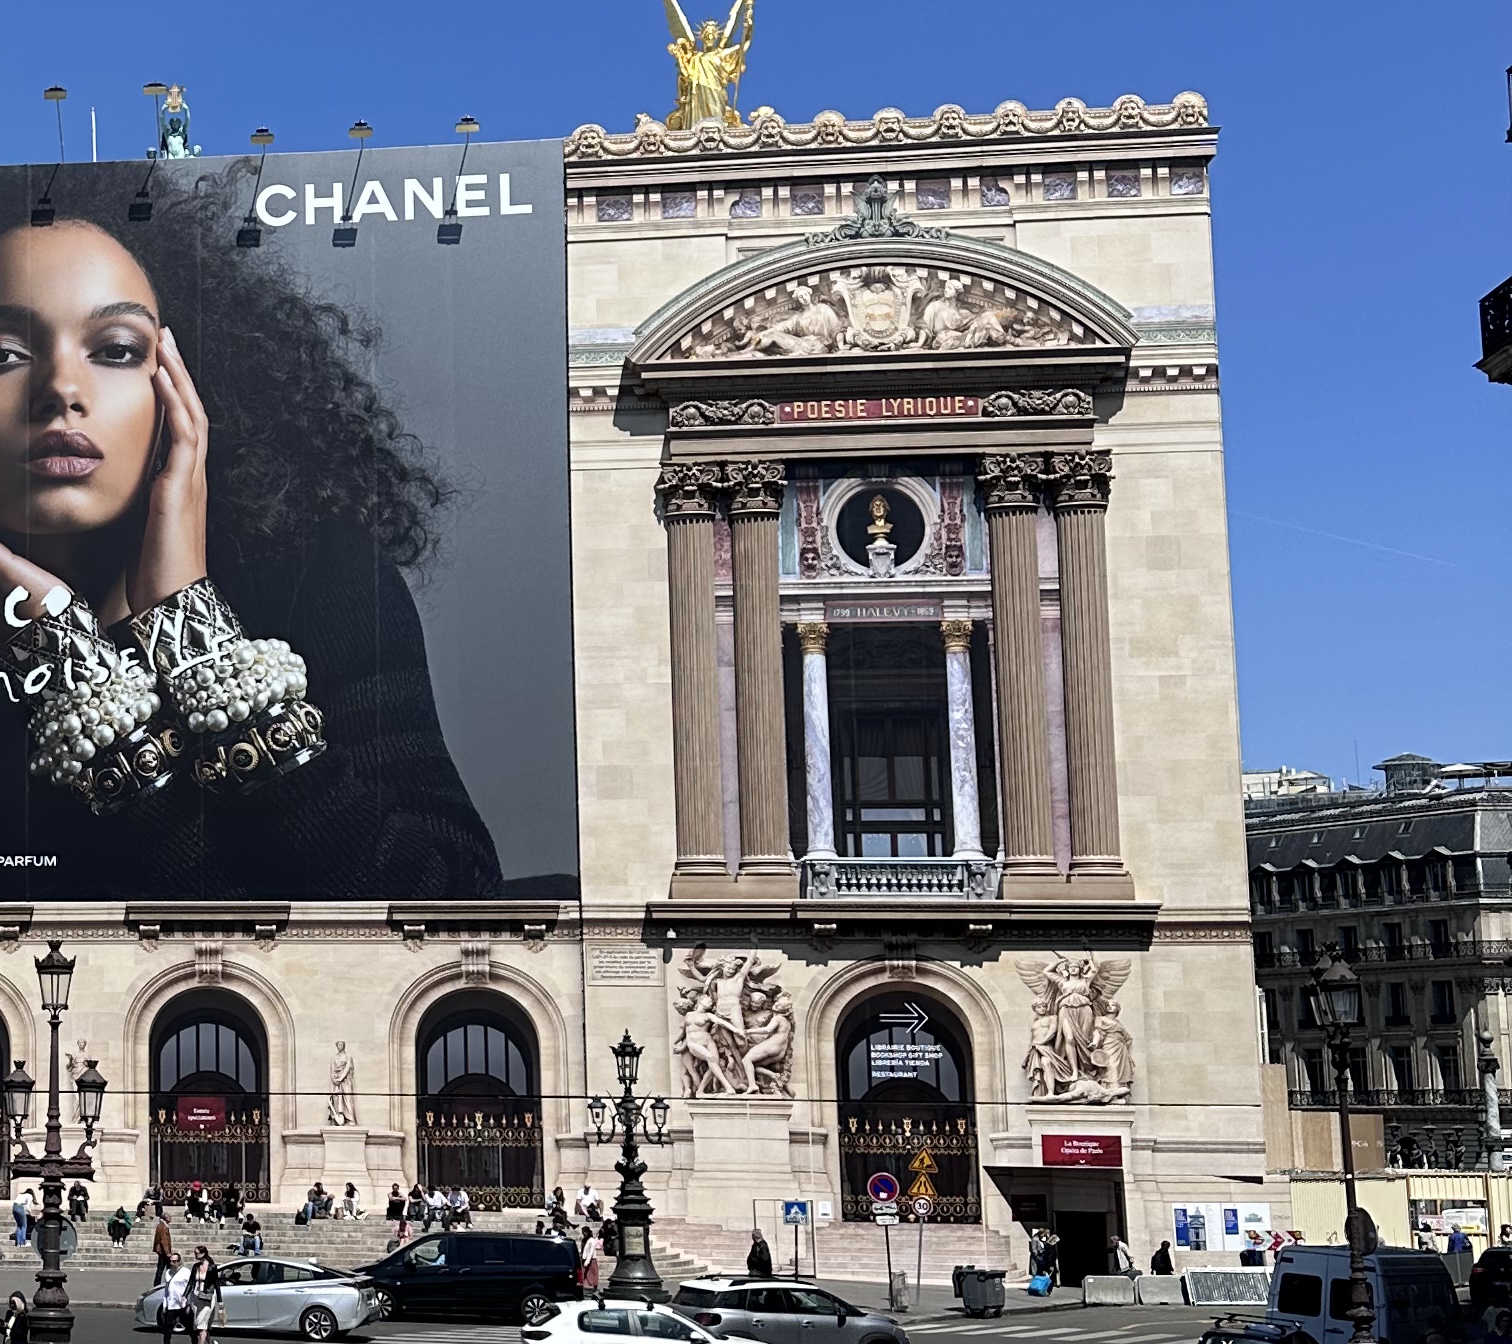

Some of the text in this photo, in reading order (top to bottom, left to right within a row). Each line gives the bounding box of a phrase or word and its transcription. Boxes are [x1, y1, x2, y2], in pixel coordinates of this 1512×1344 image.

[256, 172, 533, 227] CHANEL
[793, 396, 966, 419] POESIE LYRIQUE
